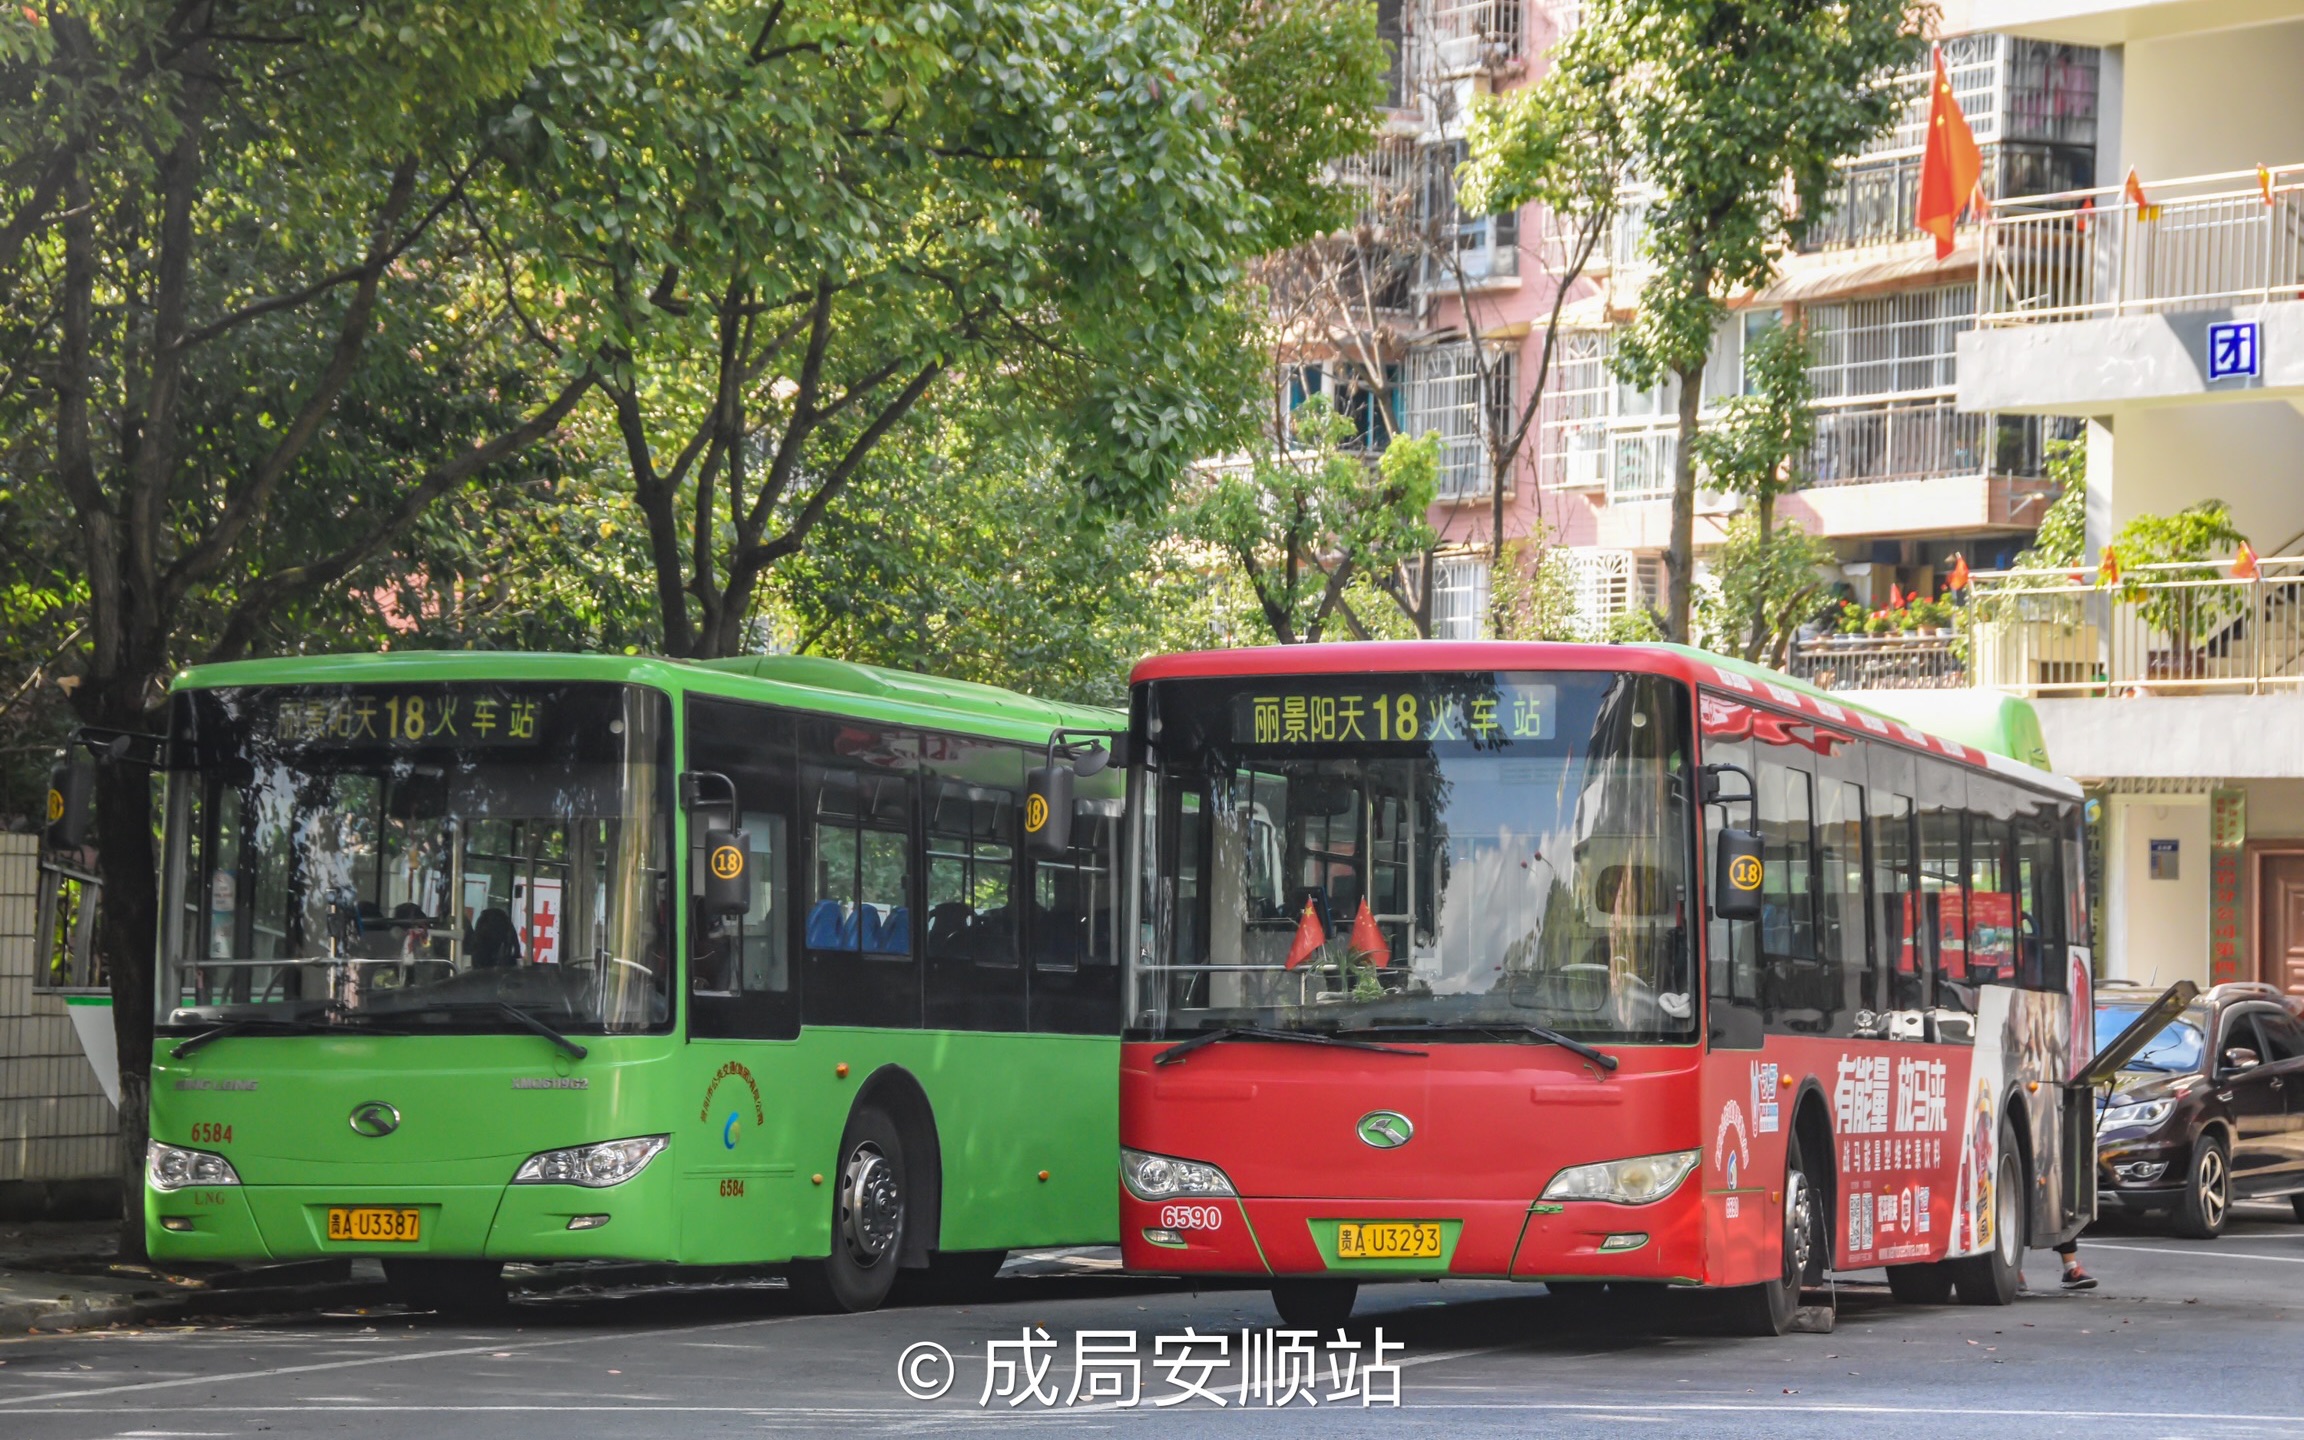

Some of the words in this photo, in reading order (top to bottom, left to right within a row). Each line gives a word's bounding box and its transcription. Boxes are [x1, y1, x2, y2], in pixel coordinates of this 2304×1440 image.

[2209, 323, 2256, 378] 团
[717, 853, 738, 872] 18
[1737, 862, 1758, 883] 18
[1834, 1053, 1890, 1134] 有能量
[1895, 1055, 1947, 1132] 放马来
[191, 1122, 233, 1143] 6584
[194, 1191, 225, 1205] LNG
[719, 1179, 745, 1197] 6584
[1160, 1205, 1222, 1230] 6590
